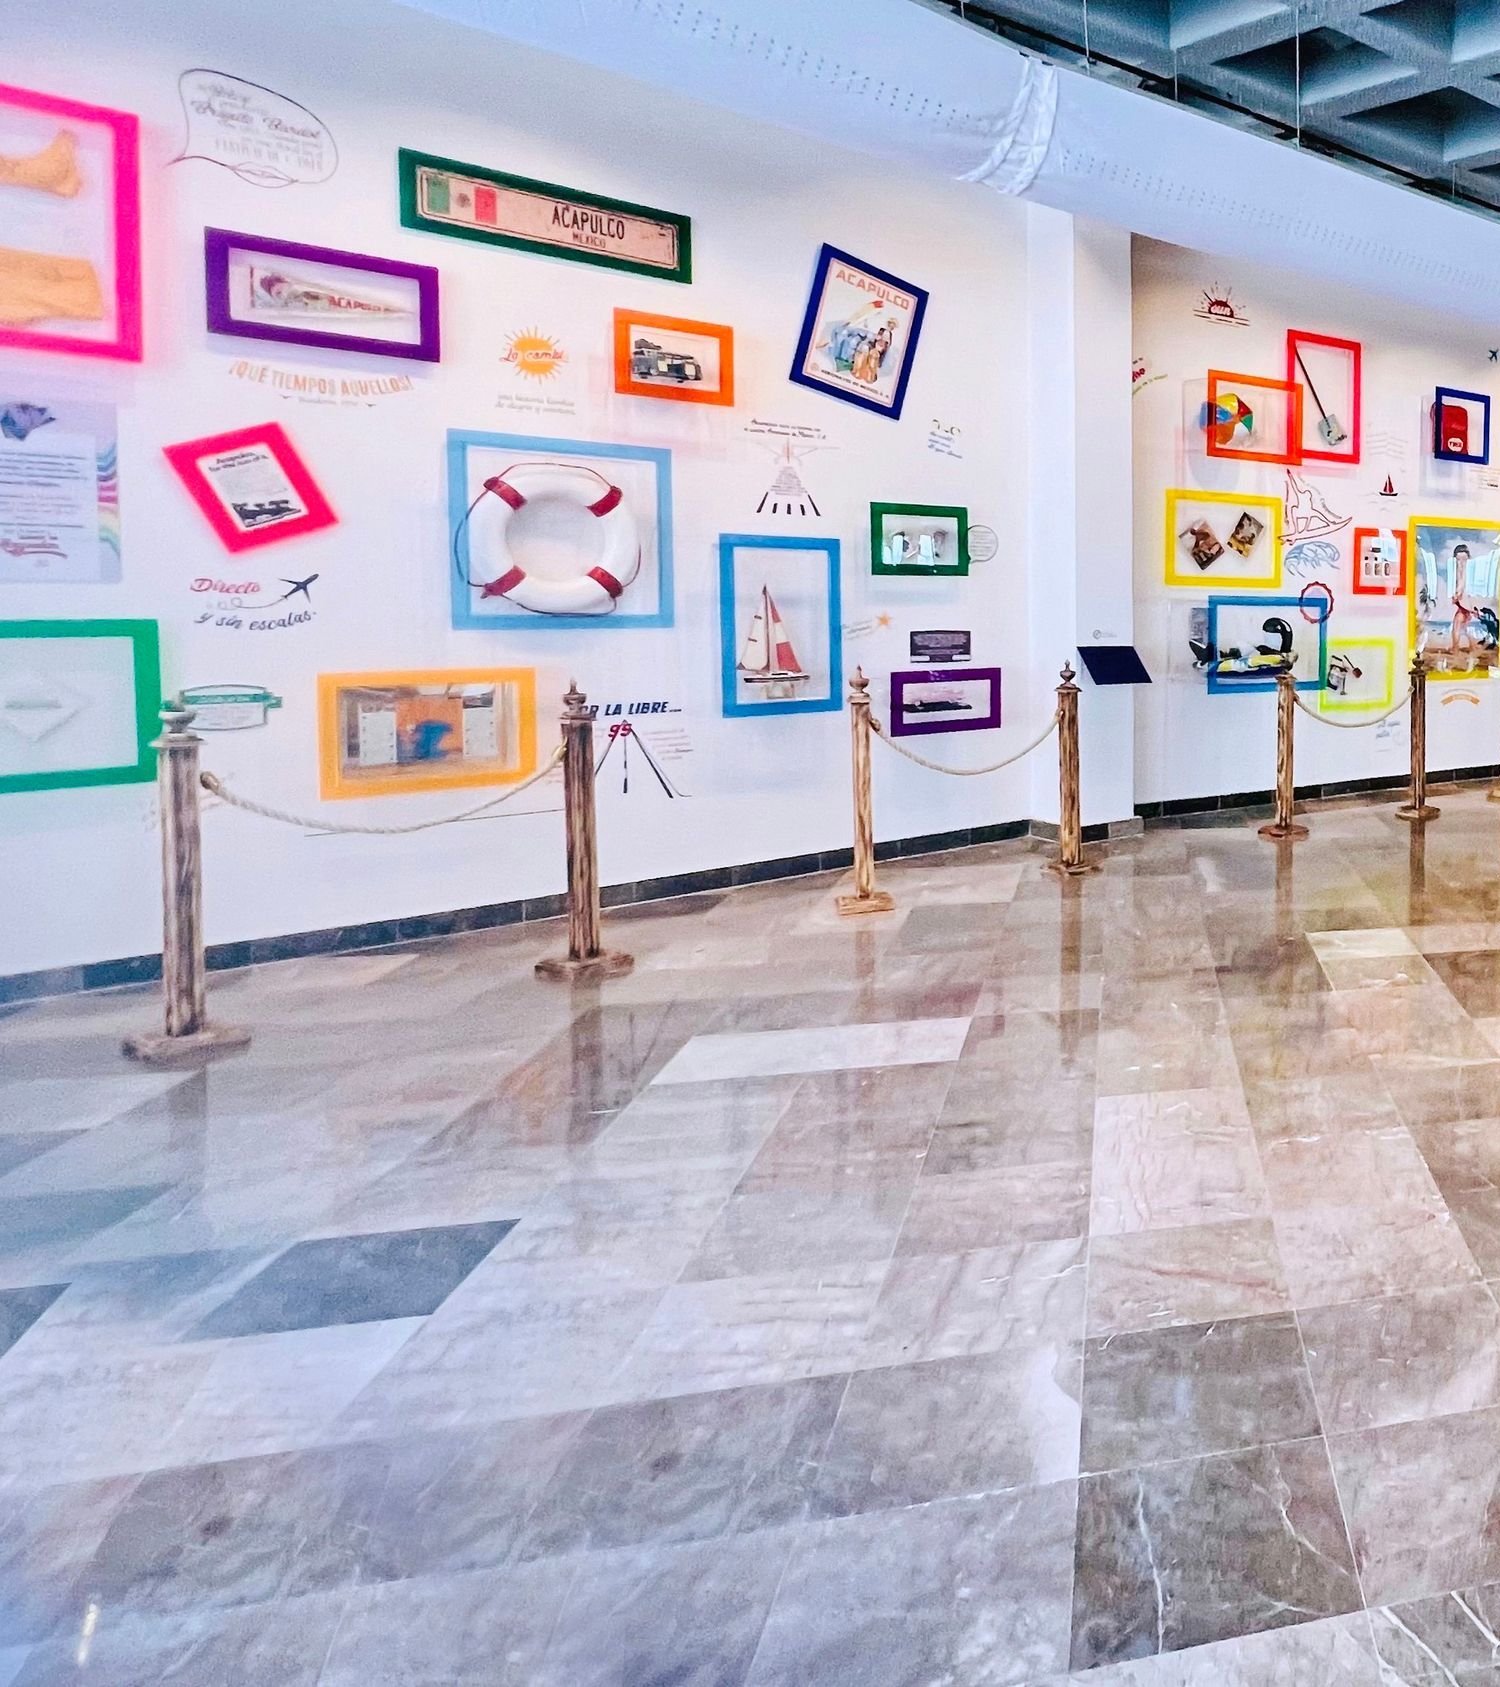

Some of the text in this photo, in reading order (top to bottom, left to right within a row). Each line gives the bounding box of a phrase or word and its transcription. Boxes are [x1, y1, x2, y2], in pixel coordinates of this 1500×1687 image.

[552, 205, 625, 240] ACAPULCO
[836, 269, 909, 310] ACAPULCO
[272, 370, 336, 396] TIEMPOS
[191, 578, 260, 594] Directo
[215, 616, 243, 630] sin
[605, 704, 622, 716] LA
